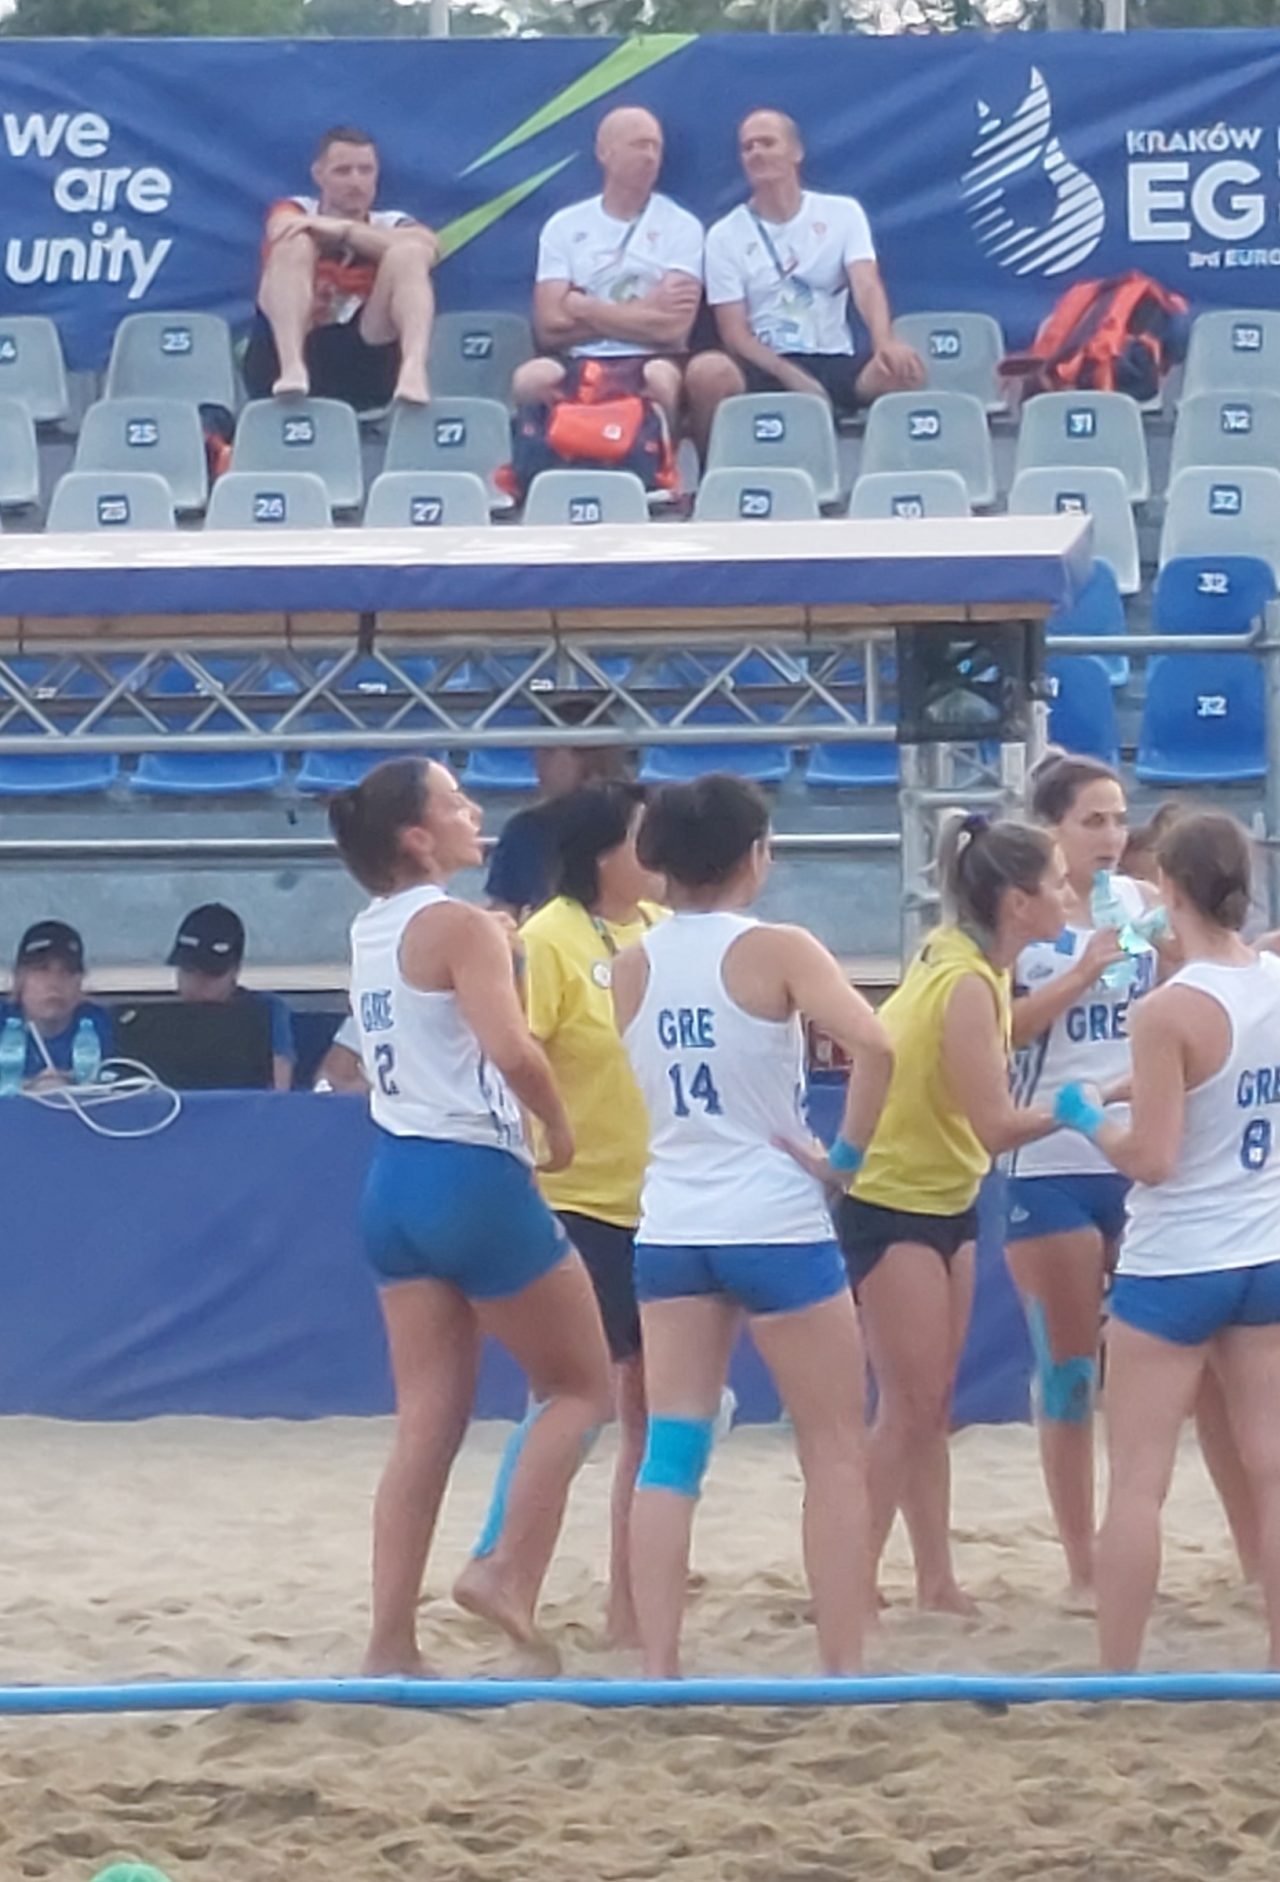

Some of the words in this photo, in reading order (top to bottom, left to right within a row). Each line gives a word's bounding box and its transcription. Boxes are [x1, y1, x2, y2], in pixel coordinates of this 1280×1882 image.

[2, 110, 111, 158] we
[1127, 122, 1264, 154] KRAKÓW
[53, 165, 173, 213] are
[5, 220, 173, 299] unity
[658, 1007, 717, 1050] GRE
[1066, 1002, 1129, 1042] GRE
[374, 1043, 401, 1096] 2
[668, 1062, 723, 1118] 14
[1242, 1118, 1272, 1170] 8
